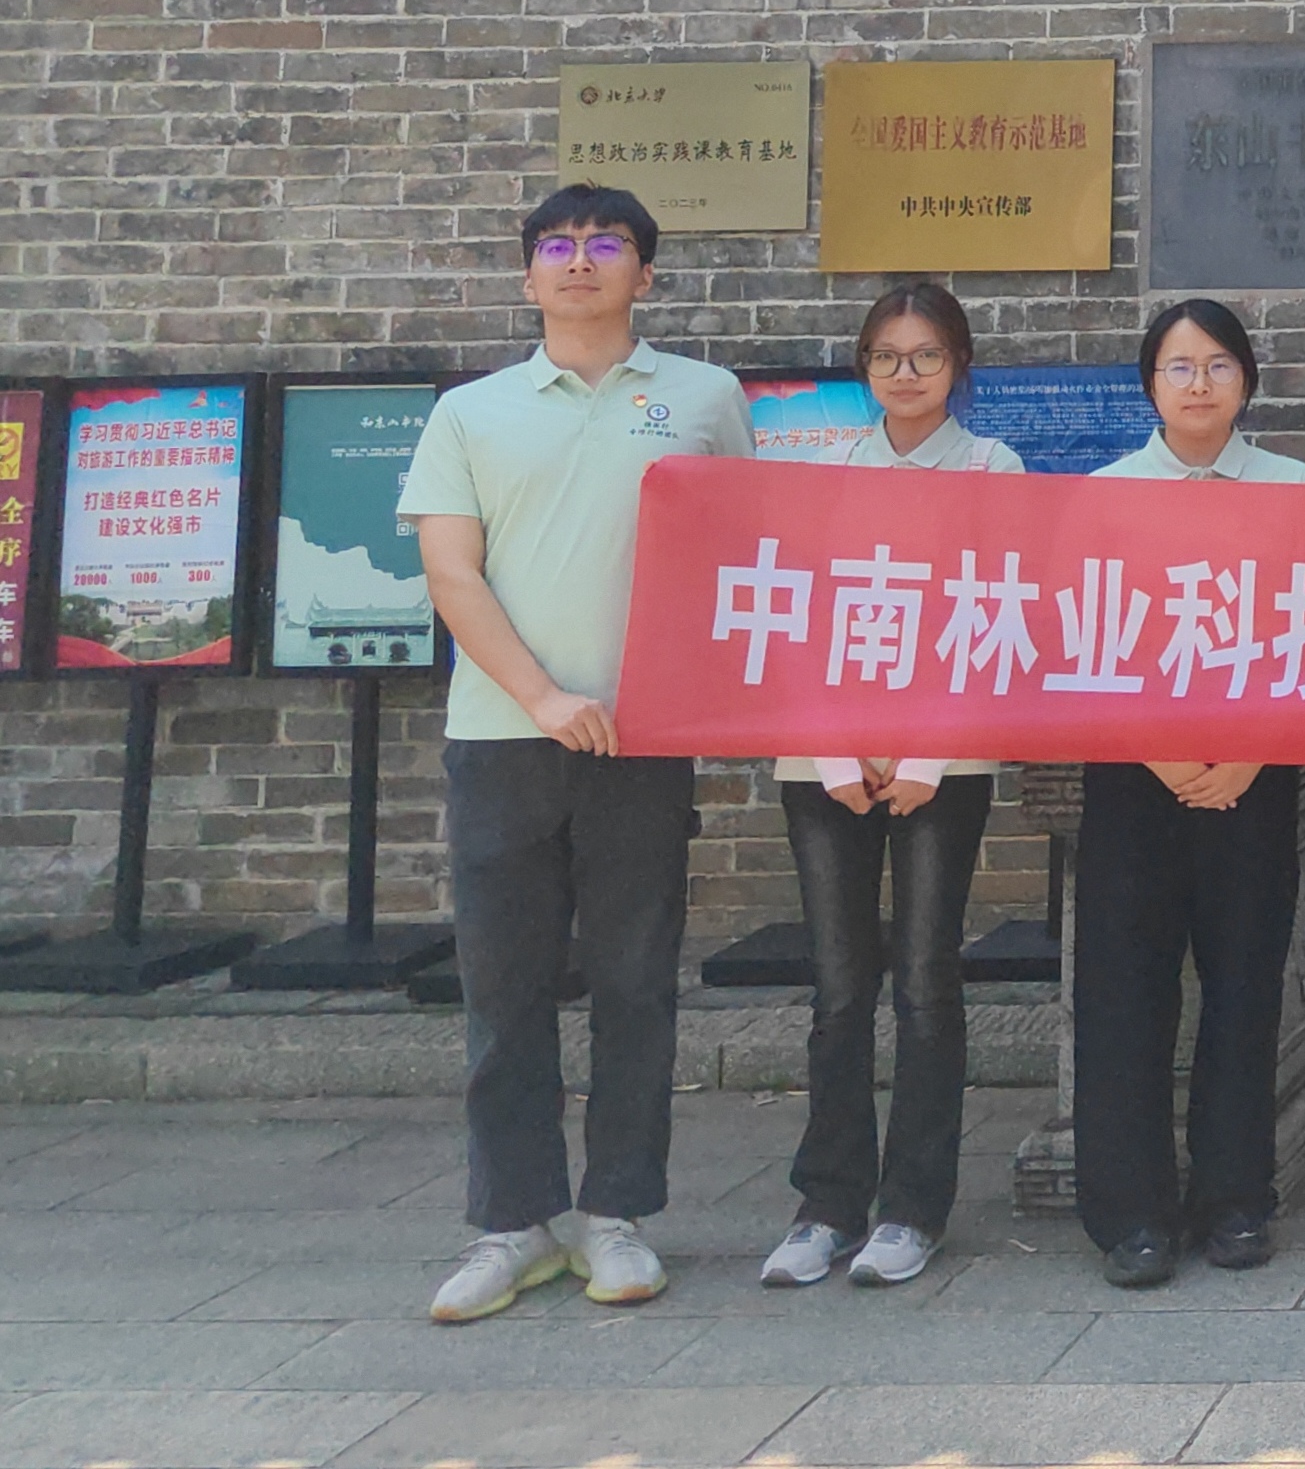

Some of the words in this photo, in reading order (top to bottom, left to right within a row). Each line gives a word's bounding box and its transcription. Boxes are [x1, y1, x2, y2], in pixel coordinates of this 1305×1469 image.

[850, 113, 1088, 152] 全国爱国主义教育示范基地
[568, 139, 797, 163] 思想政治实践课教育基地
[901, 195, 1033, 218] 中共中央宣传部
[79, 419, 237, 443] 学习贯彻习近平总书记
[77, 446, 235, 470] 对旅游工作的重要指示精神
[84, 487, 221, 511] 打造经典红色名片
[98, 515, 202, 537] 建设文化强市
